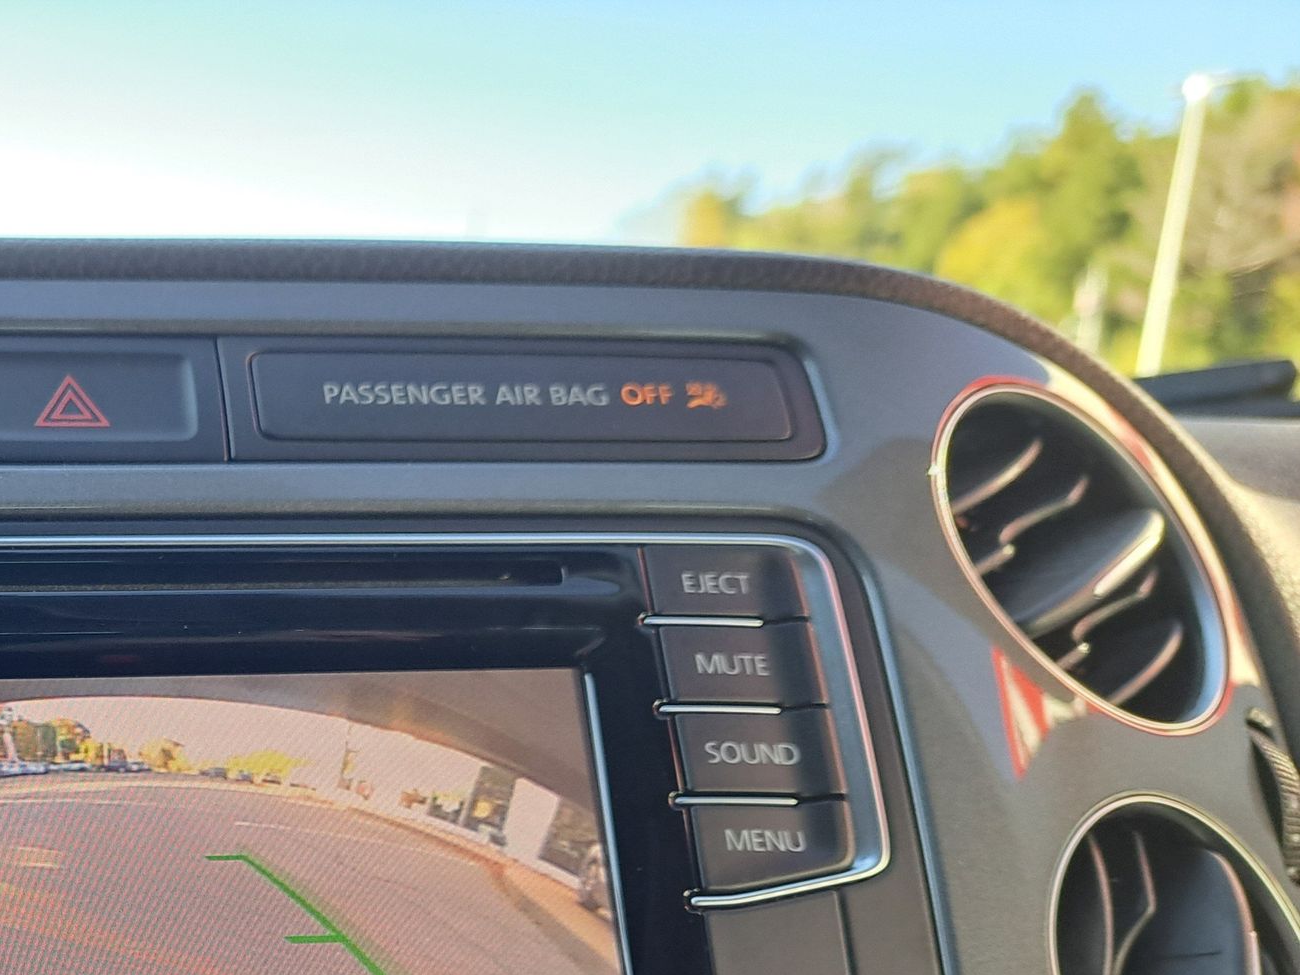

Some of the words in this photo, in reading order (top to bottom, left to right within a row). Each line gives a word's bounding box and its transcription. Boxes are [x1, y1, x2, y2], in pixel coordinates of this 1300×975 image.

[322, 383, 486, 405] PASSENGER
[495, 384, 542, 405] AIR
[549, 385, 609, 406] BAG
[620, 384, 673, 406] OFF
[680, 570, 750, 595] EJECT
[695, 652, 771, 677] MUTE
[704, 741, 800, 766] SOUND
[724, 828, 807, 852] MENU
